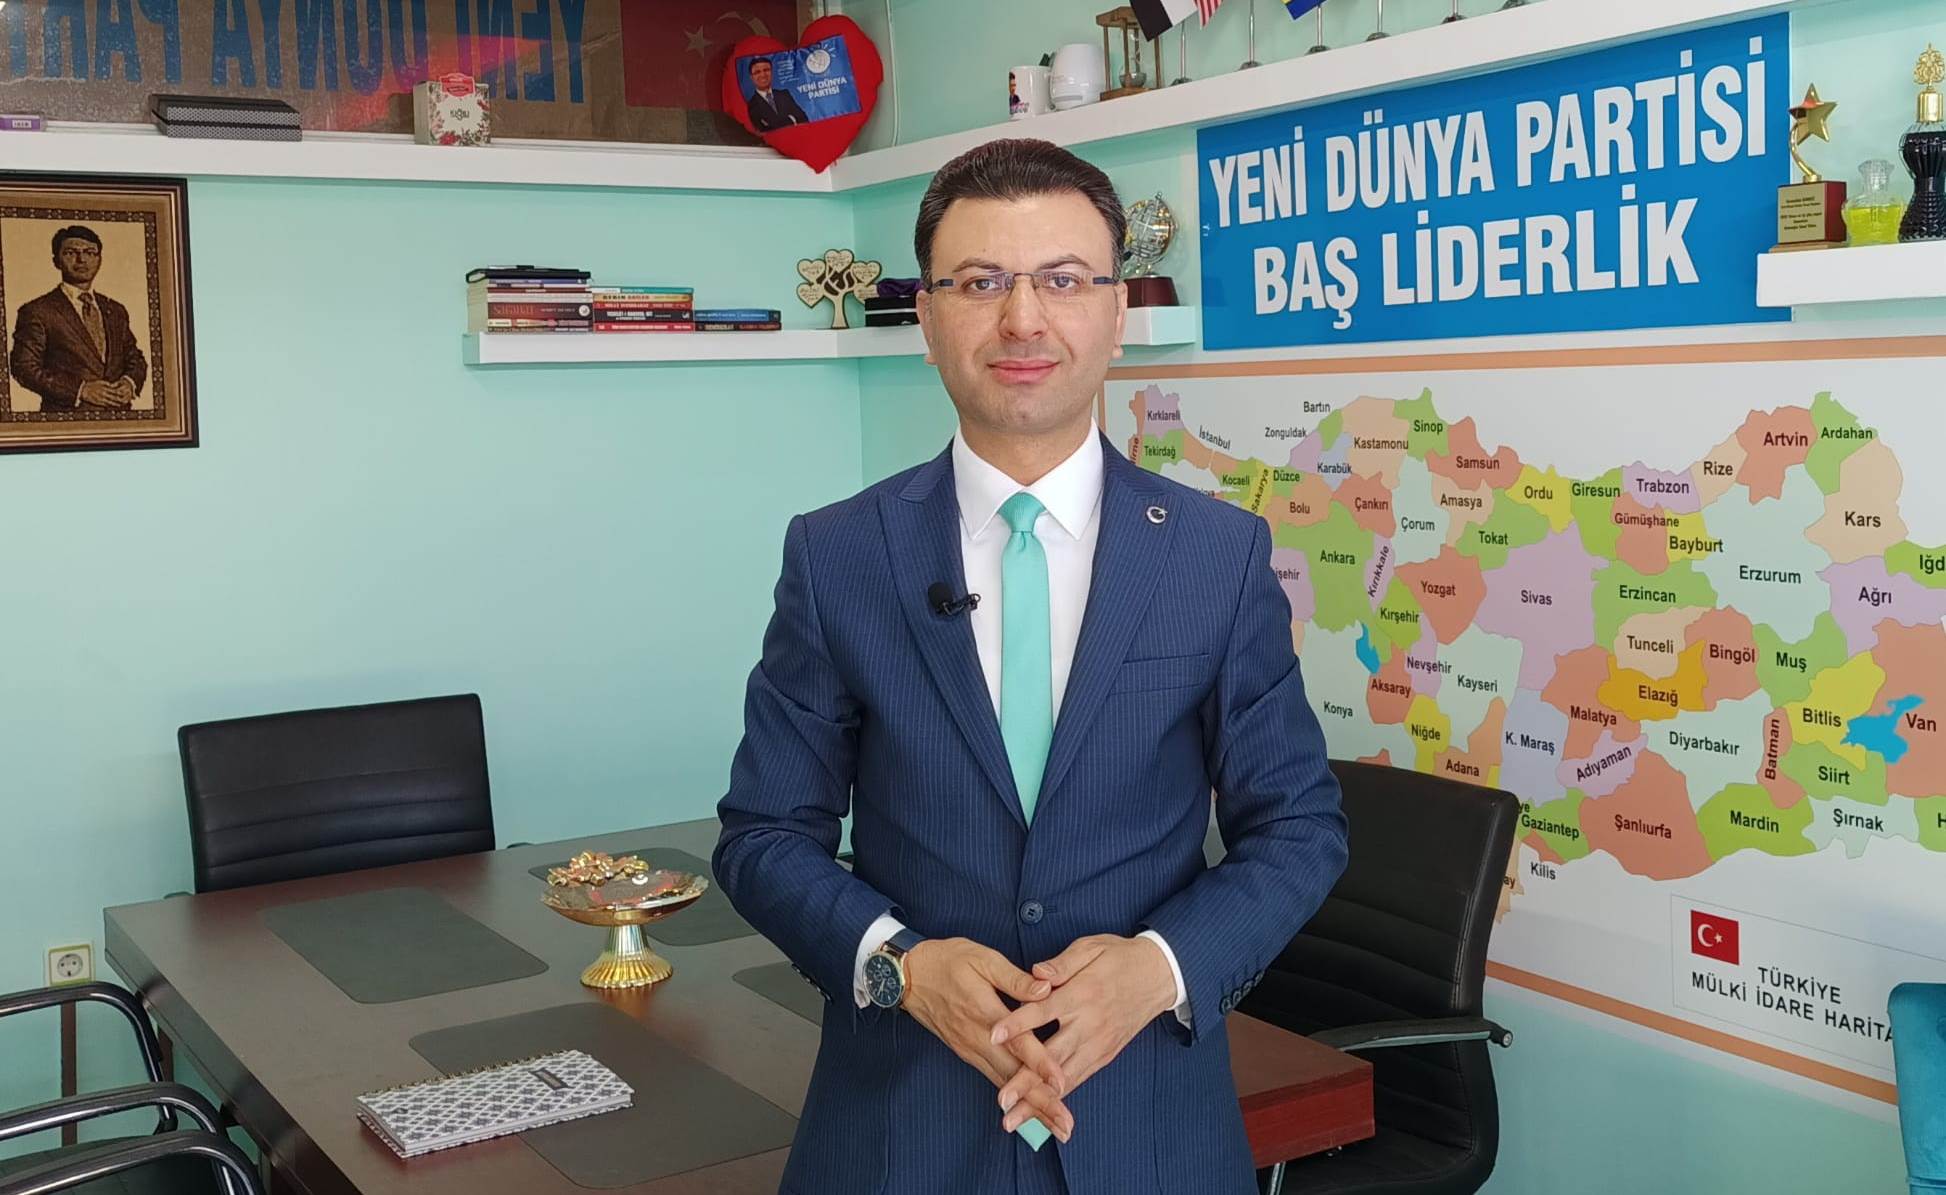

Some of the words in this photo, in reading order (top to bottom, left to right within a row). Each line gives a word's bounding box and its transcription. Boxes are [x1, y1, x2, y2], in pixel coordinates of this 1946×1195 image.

[818, 76, 847, 89] DÜNYA
[808, 87, 840, 100] PARTİSİ
[1208, 125, 1307, 229] YENİ
[1325, 109, 1495, 214] DÜNYA
[1516, 36, 1766, 188] PARTİSİ
[1253, 236, 1359, 330] BAŞ
[1382, 184, 1700, 306] LİDERLİK
[1147, 410, 1180, 421] Kırklareli
[1304, 402, 1330, 413] Bartın
[1265, 428, 1307, 440] Zonguldak
[1414, 420, 1443, 435] Sinop
[1821, 427, 1872, 439] Ardahan
[1200, 426, 1230, 450] İstanbul
[1354, 438, 1408, 449] Kastamonu
[1764, 432, 1808, 447] Artvin
[1144, 445, 1176, 459] Tekirdağ
[1318, 463, 1352, 474] Karabük
[1456, 456, 1500, 469] Samsun
[1703, 462, 1733, 476] Rize
[1222, 475, 1250, 486] Kocaeli
[1273, 470, 1300, 482] Düzce
[1252, 469, 1269, 512] Sakarya
[1524, 486, 1552, 500] Ordu
[1572, 482, 1620, 498] Giresun
[1636, 480, 1689, 494] Trabzon
[1290, 502, 1310, 514] Bolu
[1355, 498, 1388, 512] Çankırı
[1440, 494, 1482, 510] Amasya
[1402, 518, 1435, 532] Çorum
[1615, 513, 1679, 528] Gümüşhane
[1845, 512, 1881, 527] Kars
[1479, 531, 1508, 545] Tokat
[1670, 536, 1723, 554] Bayburt
[1320, 550, 1355, 565] Ankara
[1920, 553, 1945, 574] Iğd
[1275, 567, 1300, 581] işehir
[1368, 546, 1389, 597] Kırıkkale
[1740, 566, 1801, 584] Erzurum
[1420, 581, 1456, 598] Yozgat
[1521, 590, 1552, 605] Sivas
[1619, 585, 1676, 603] Erzincan
[1858, 586, 1892, 607] Ağrı
[1380, 608, 1419, 623] Kırşehir
[1627, 635, 1673, 654] Tunceli
[1710, 644, 1755, 664] Bingöl
[1776, 653, 1807, 672] Muş
[1407, 656, 1452, 674] Nevşehir
[1371, 679, 1411, 697] Aksaray
[1457, 675, 1497, 692] Kayseri
[1639, 686, 1678, 707] Elazığ
[1324, 702, 1353, 716] Konya
[1570, 706, 1617, 726] Malatya
[1803, 709, 1841, 727] Bitlis
[1906, 713, 1937, 732] Van
[1411, 725, 1440, 741] Niğde
[1506, 732, 1517, 745] K.
[1520, 733, 1555, 756] Maraş
[1669, 731, 1739, 756] Diyarbakır
[1765, 719, 1780, 779] Batman
[1446, 760, 1479, 776] Adana
[1577, 746, 1631, 781] Adıyaman
[1818, 767, 1850, 786] Siirt
[1522, 814, 1580, 841] Gaziantep
[1614, 814, 1672, 839] Şanlıurfa
[1730, 810, 1780, 834] Mardin
[1832, 808, 1884, 832] Şırnak
[1530, 862, 1556, 880] Kilis
[1758, 966, 1841, 1004] TÜRKİYE
[1692, 971, 1746, 1002] MÜLKİ
[1756, 986, 1814, 1020] İDARE
